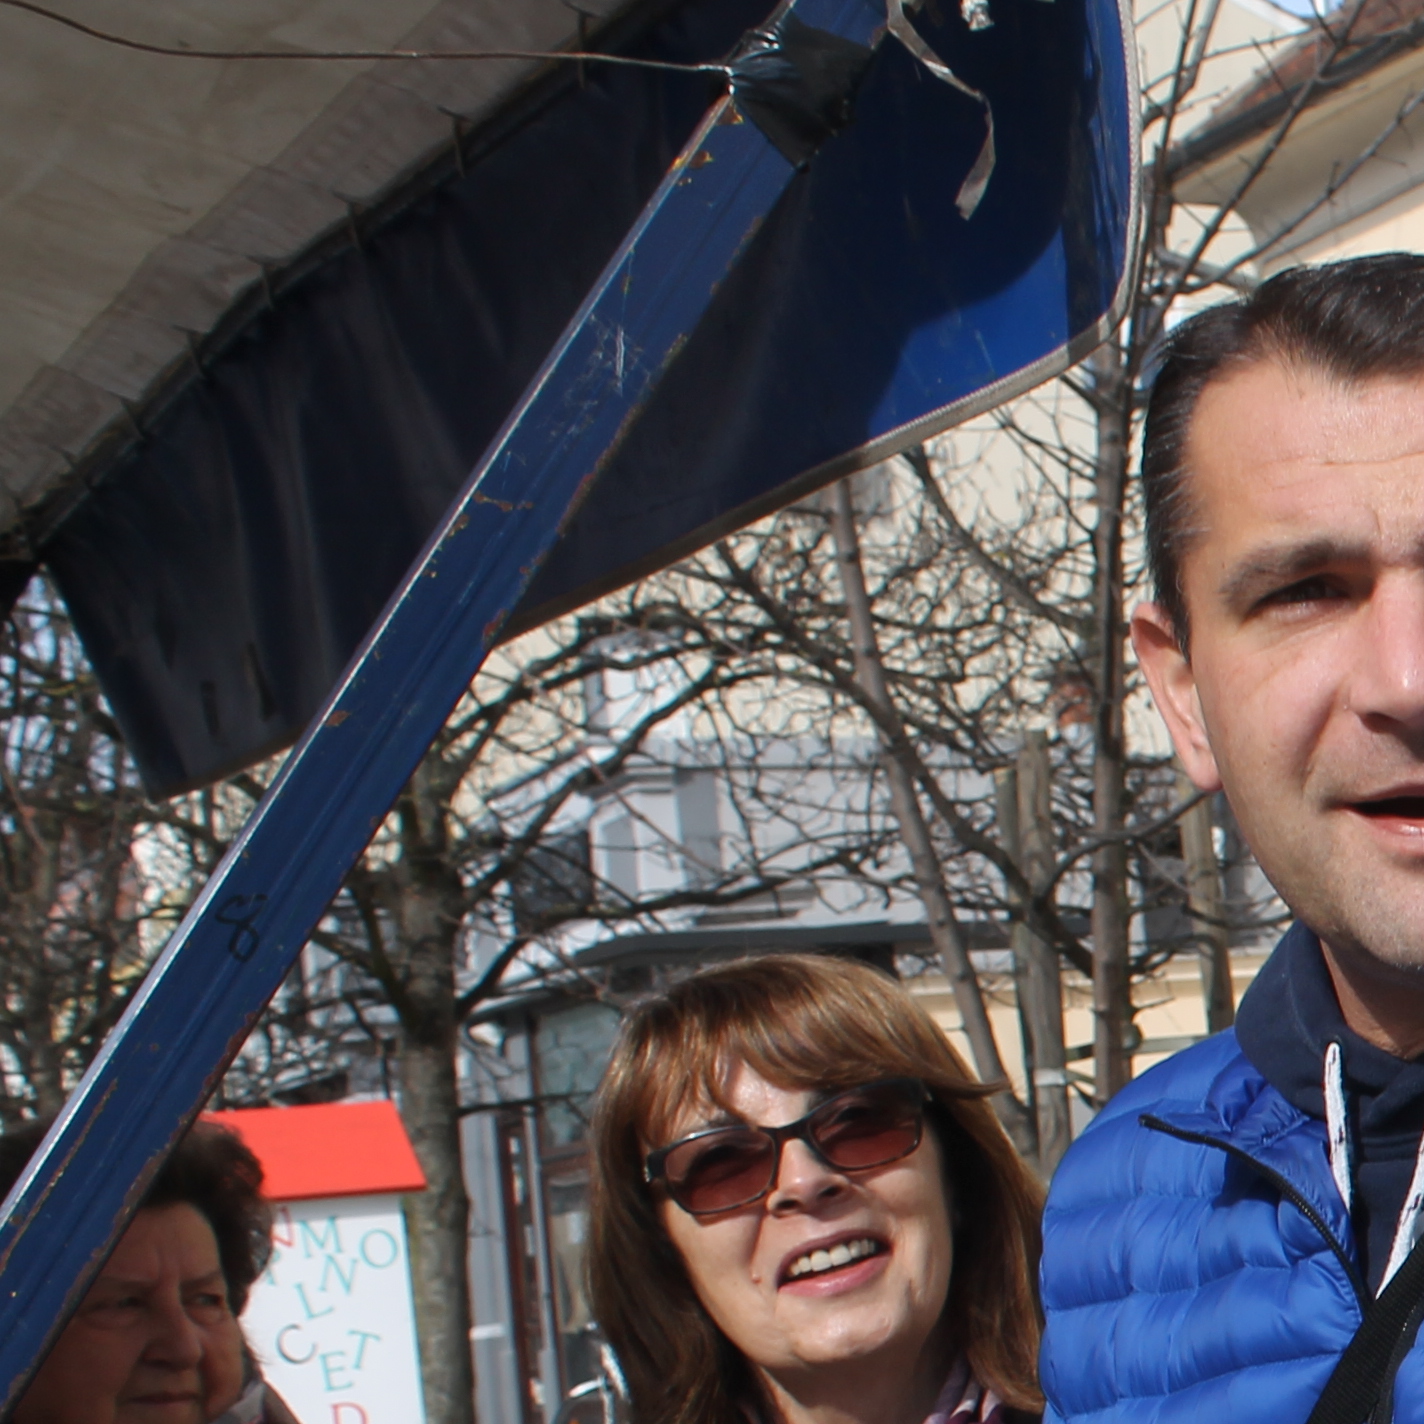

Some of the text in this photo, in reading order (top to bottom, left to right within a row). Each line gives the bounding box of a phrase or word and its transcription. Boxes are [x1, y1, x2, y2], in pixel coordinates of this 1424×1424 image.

[297, 1216, 345, 1259] M
[359, 1228, 398, 1269] O
[319, 1254, 358, 1296] N
[294, 1282, 334, 1320] L
[275, 1324, 317, 1365] C
[347, 1330, 381, 1371] T
[318, 1350, 354, 1393] E
